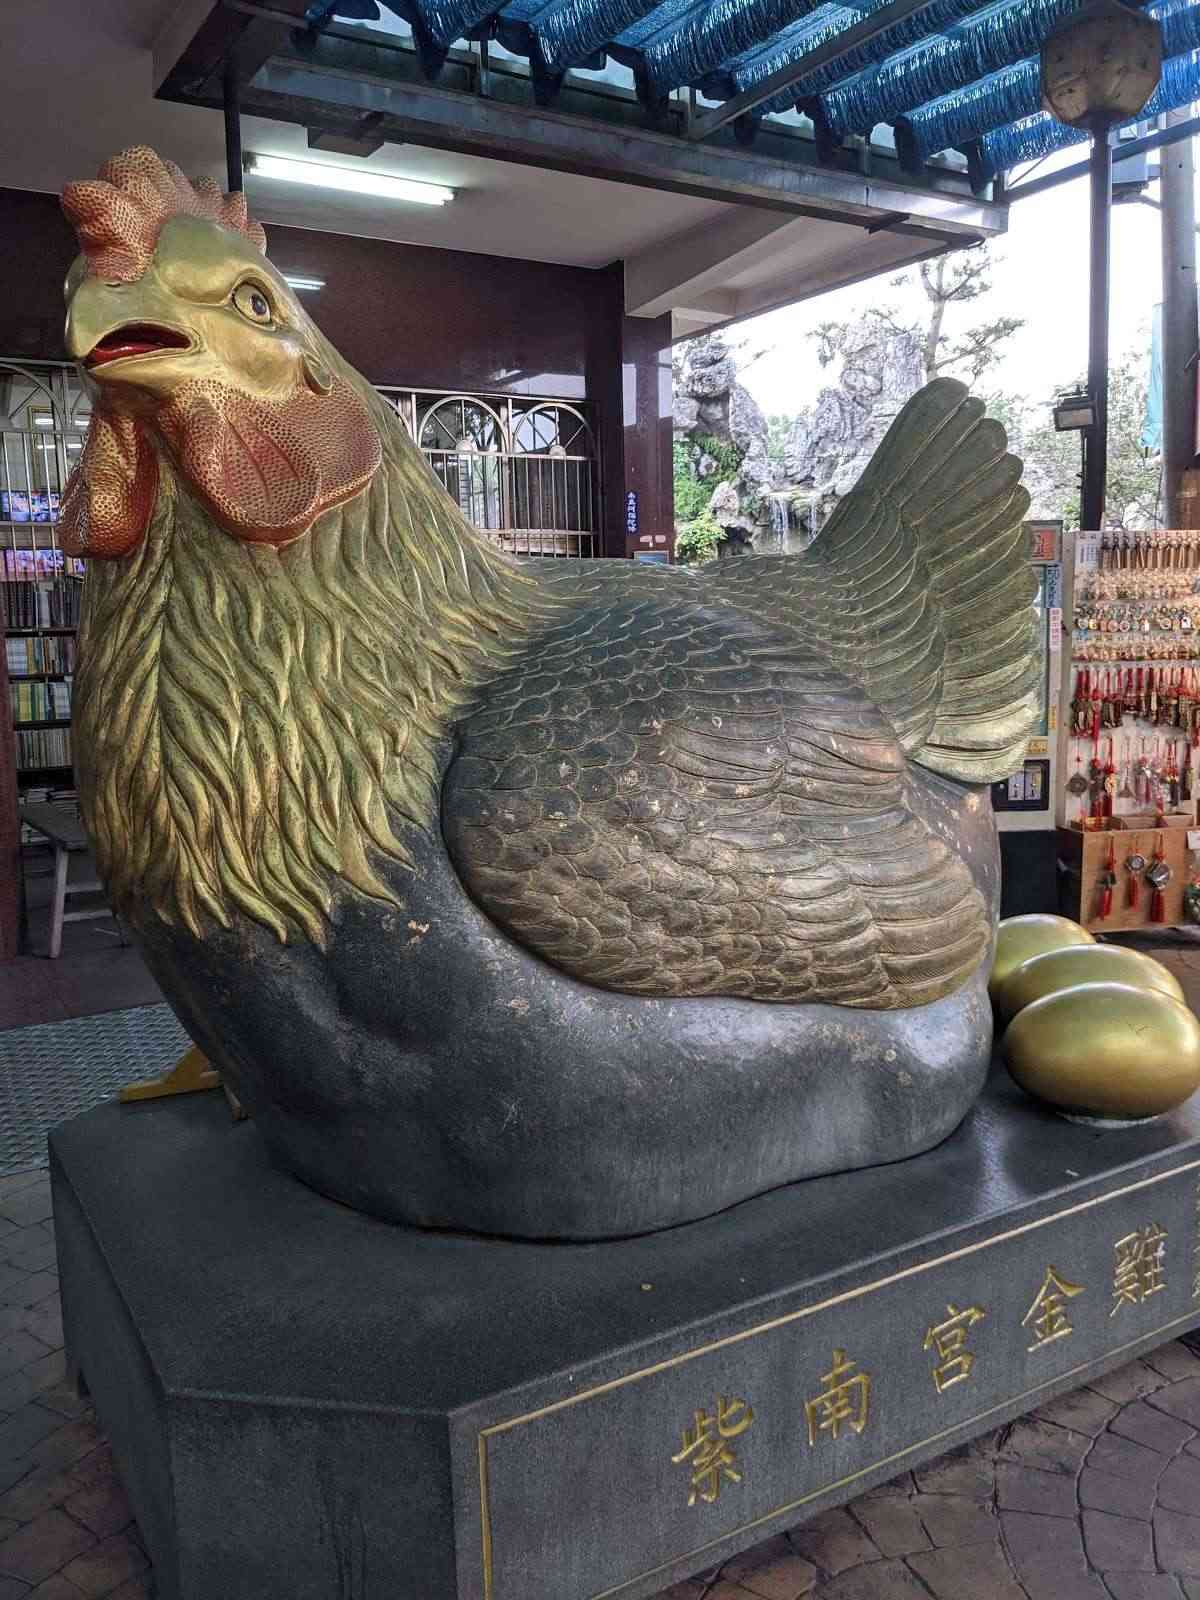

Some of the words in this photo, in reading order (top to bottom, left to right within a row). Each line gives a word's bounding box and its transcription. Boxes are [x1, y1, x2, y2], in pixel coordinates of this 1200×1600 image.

[671, 1188, 1200, 1506] 紫南宮金雞
